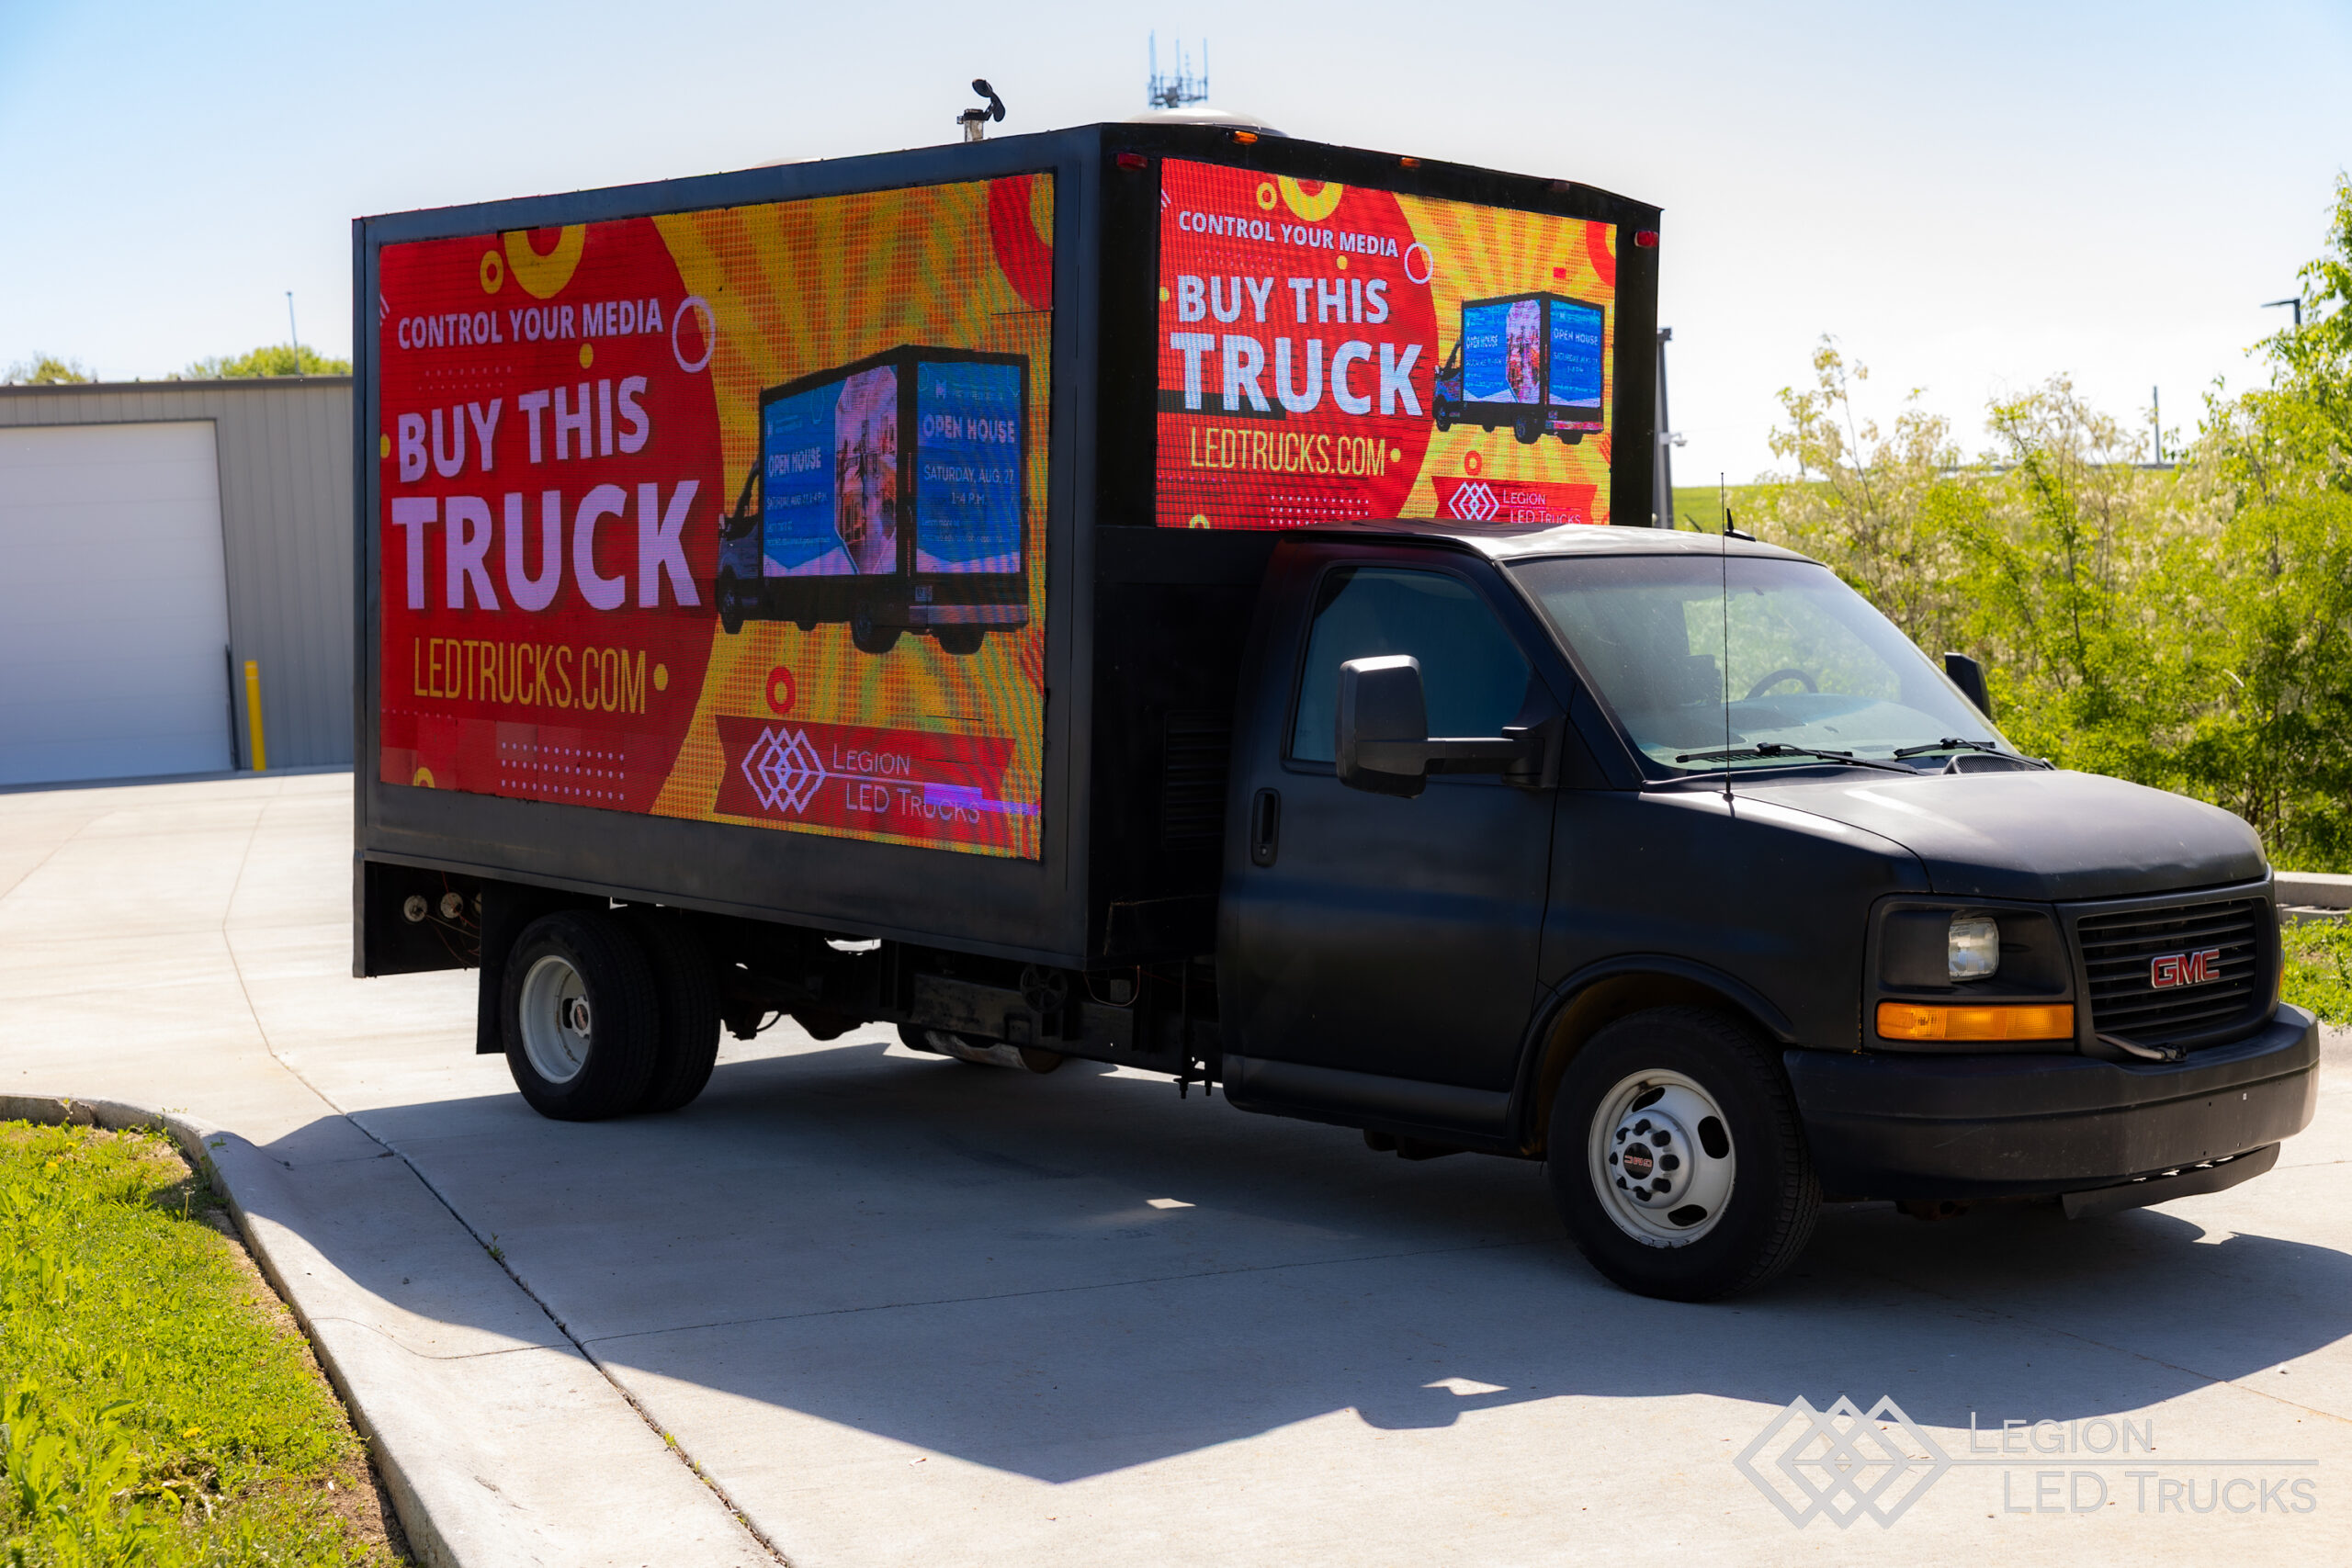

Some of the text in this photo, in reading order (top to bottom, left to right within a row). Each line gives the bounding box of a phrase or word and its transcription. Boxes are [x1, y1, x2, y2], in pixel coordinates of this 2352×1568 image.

[1179, 210, 1398, 258] CONTROL YOUR MEDIA
[1177, 275, 1389, 323] BUY THIS
[398, 299, 663, 349] CONTROL YOUR MEDIA
[1553, 328, 1599, 346] OPEN HOUSE
[1170, 332, 1423, 416] TRUCK
[398, 376, 650, 483] BUY THIS
[923, 413, 1015, 444] OPEN HOUSE
[768, 446, 821, 478] OPEN HOUSE
[1191, 425, 1385, 477] LEDTRUCKS.COM
[1503, 489, 1546, 504] LEGION
[1510, 510, 1535, 524] LED
[391, 479, 702, 613] TRUCK
[413, 637, 646, 715] LEDTRUCKS.COM
[833, 743, 910, 776] LEGION
[846, 782, 890, 813] LED
[2151, 948, 2220, 988] GMC
